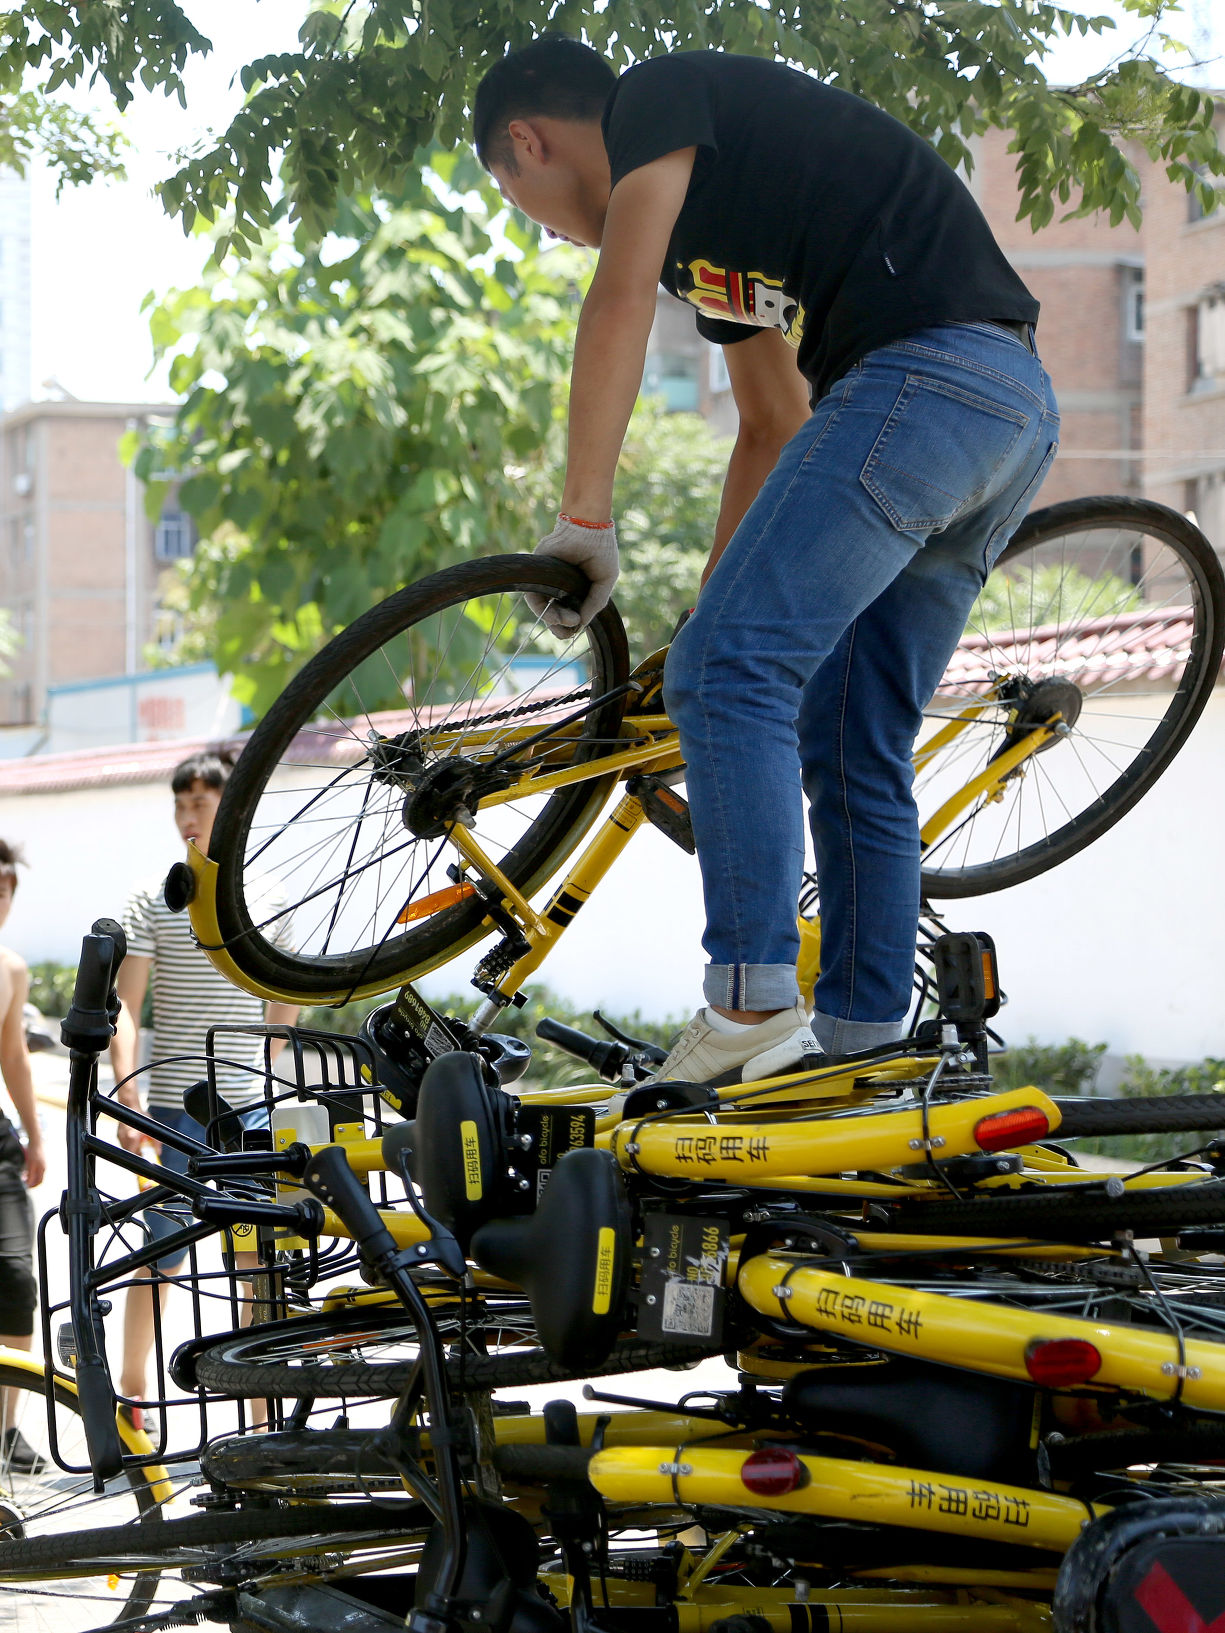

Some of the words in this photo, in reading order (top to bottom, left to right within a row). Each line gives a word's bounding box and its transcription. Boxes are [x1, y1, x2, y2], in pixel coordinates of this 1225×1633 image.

[539, 1114, 551, 1147] bicycle
[465, 1136, 480, 1184] 扫码用车
[539, 1148, 548, 1166] ofo
[675, 1136, 771, 1166] 扫码用车
[668, 1224, 680, 1259] bicycle
[597, 1246, 610, 1296] 扫码用车
[686, 1265, 699, 1281] NO
[816, 1287, 923, 1340] 扫码用车
[906, 1479, 1031, 1528] 扫码用车
